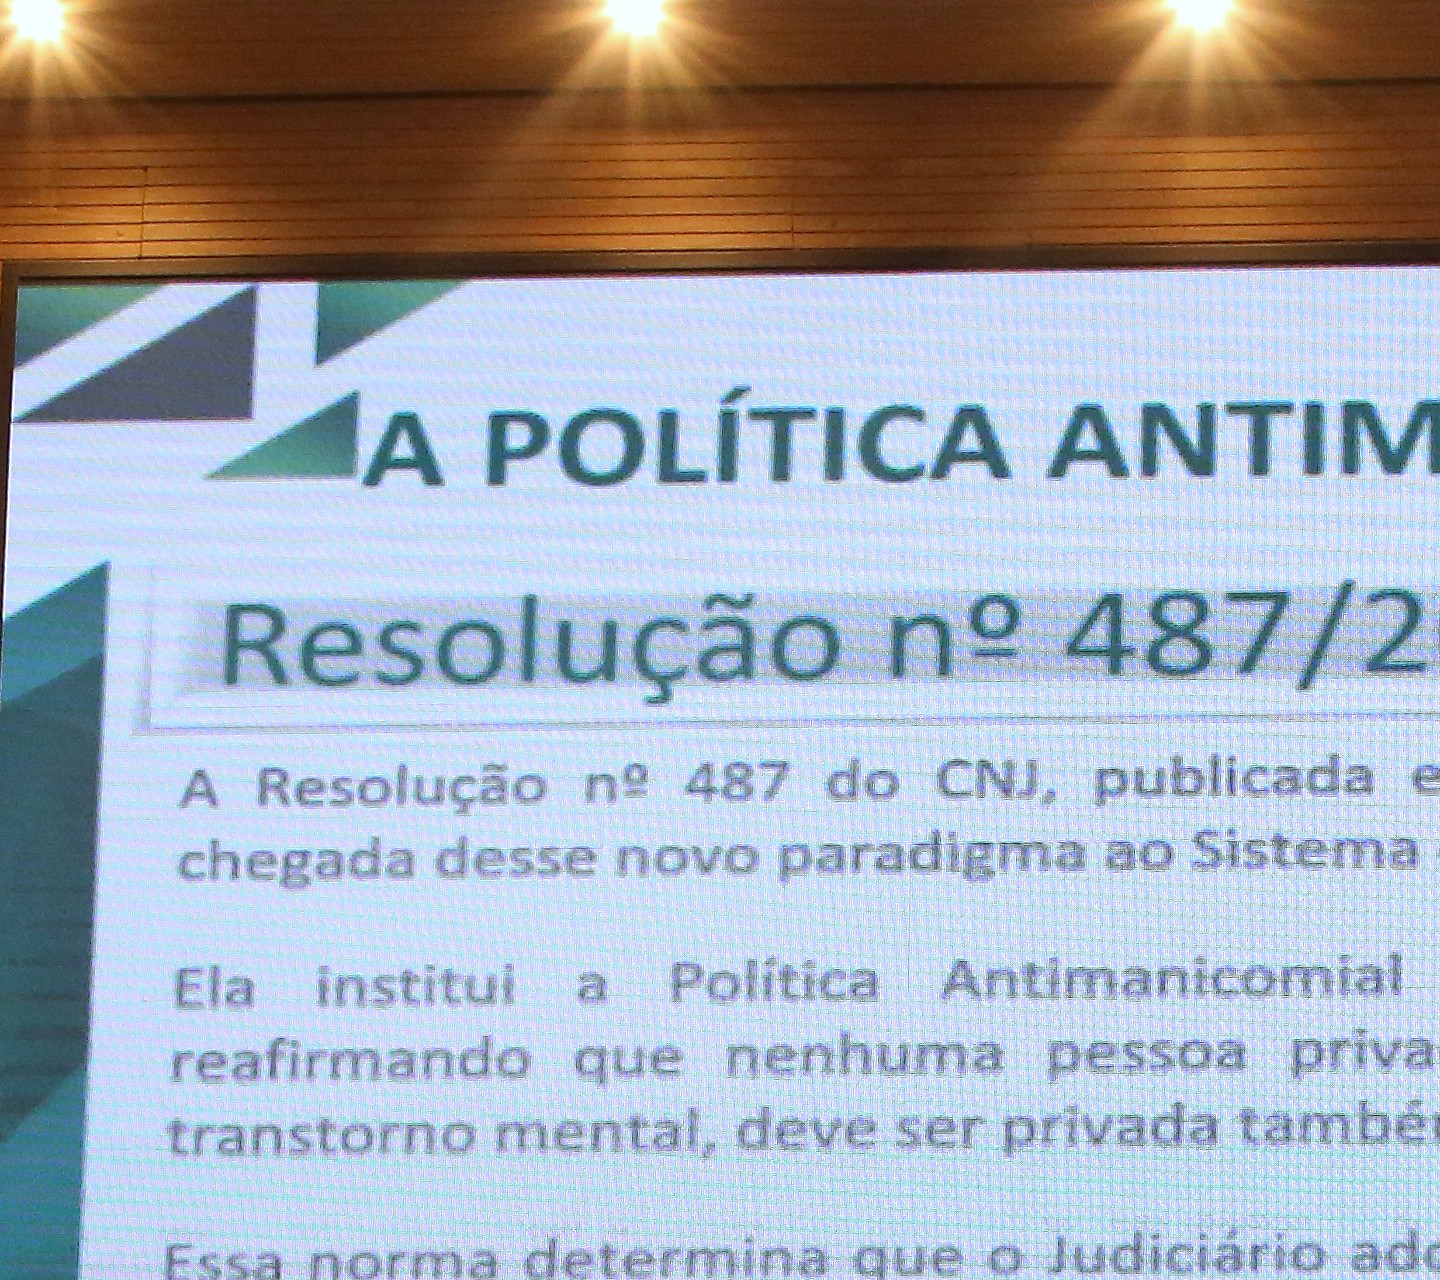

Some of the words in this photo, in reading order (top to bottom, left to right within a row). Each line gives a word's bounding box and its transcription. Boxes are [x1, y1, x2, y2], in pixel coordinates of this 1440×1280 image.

[361, 411, 445, 486] A
[485, 386, 1012, 485] POLÍTICA
[222, 591, 843, 704] Resolução
[888, 593, 1023, 681] nº
[179, 768, 219, 808] A
[257, 763, 548, 815] Resolução
[585, 762, 649, 803] nº
[684, 760, 791, 802] 487
[825, 758, 900, 801] do
[935, 757, 1056, 805] CNJ,
[1094, 753, 1374, 807] publicada
[177, 837, 415, 890] chegada
[435, 836, 597, 879] desse
[617, 844, 760, 876] novo
[779, 829, 1086, 883] paradigma
[1105, 839, 1175, 872] ao
[1192, 828, 1420, 871] Sistema
[174, 965, 255, 1010] Ela
[317, 964, 514, 1007] institui
[577, 972, 608, 1004] a
[670, 957, 879, 1003] Política
[941, 952, 1402, 1000] Antimanicomial
[171, 1035, 532, 1083] reafirmando
[573, 1045, 683, 1086] que
[727, 1031, 1004, 1076] nenhuma
[1048, 1039, 1247, 1082] pessoa
[167, 1118, 476, 1157] transtorno
[496, 1108, 715, 1158] mental,
[736, 1106, 877, 1151] deve
[897, 1116, 984, 1149] ser
[1002, 1101, 1219, 1157] privada
[523, 1237, 829, 1280] determina
[986, 1244, 1024, 1275] o
[1048, 1228, 1327, 1275] Judiciário
